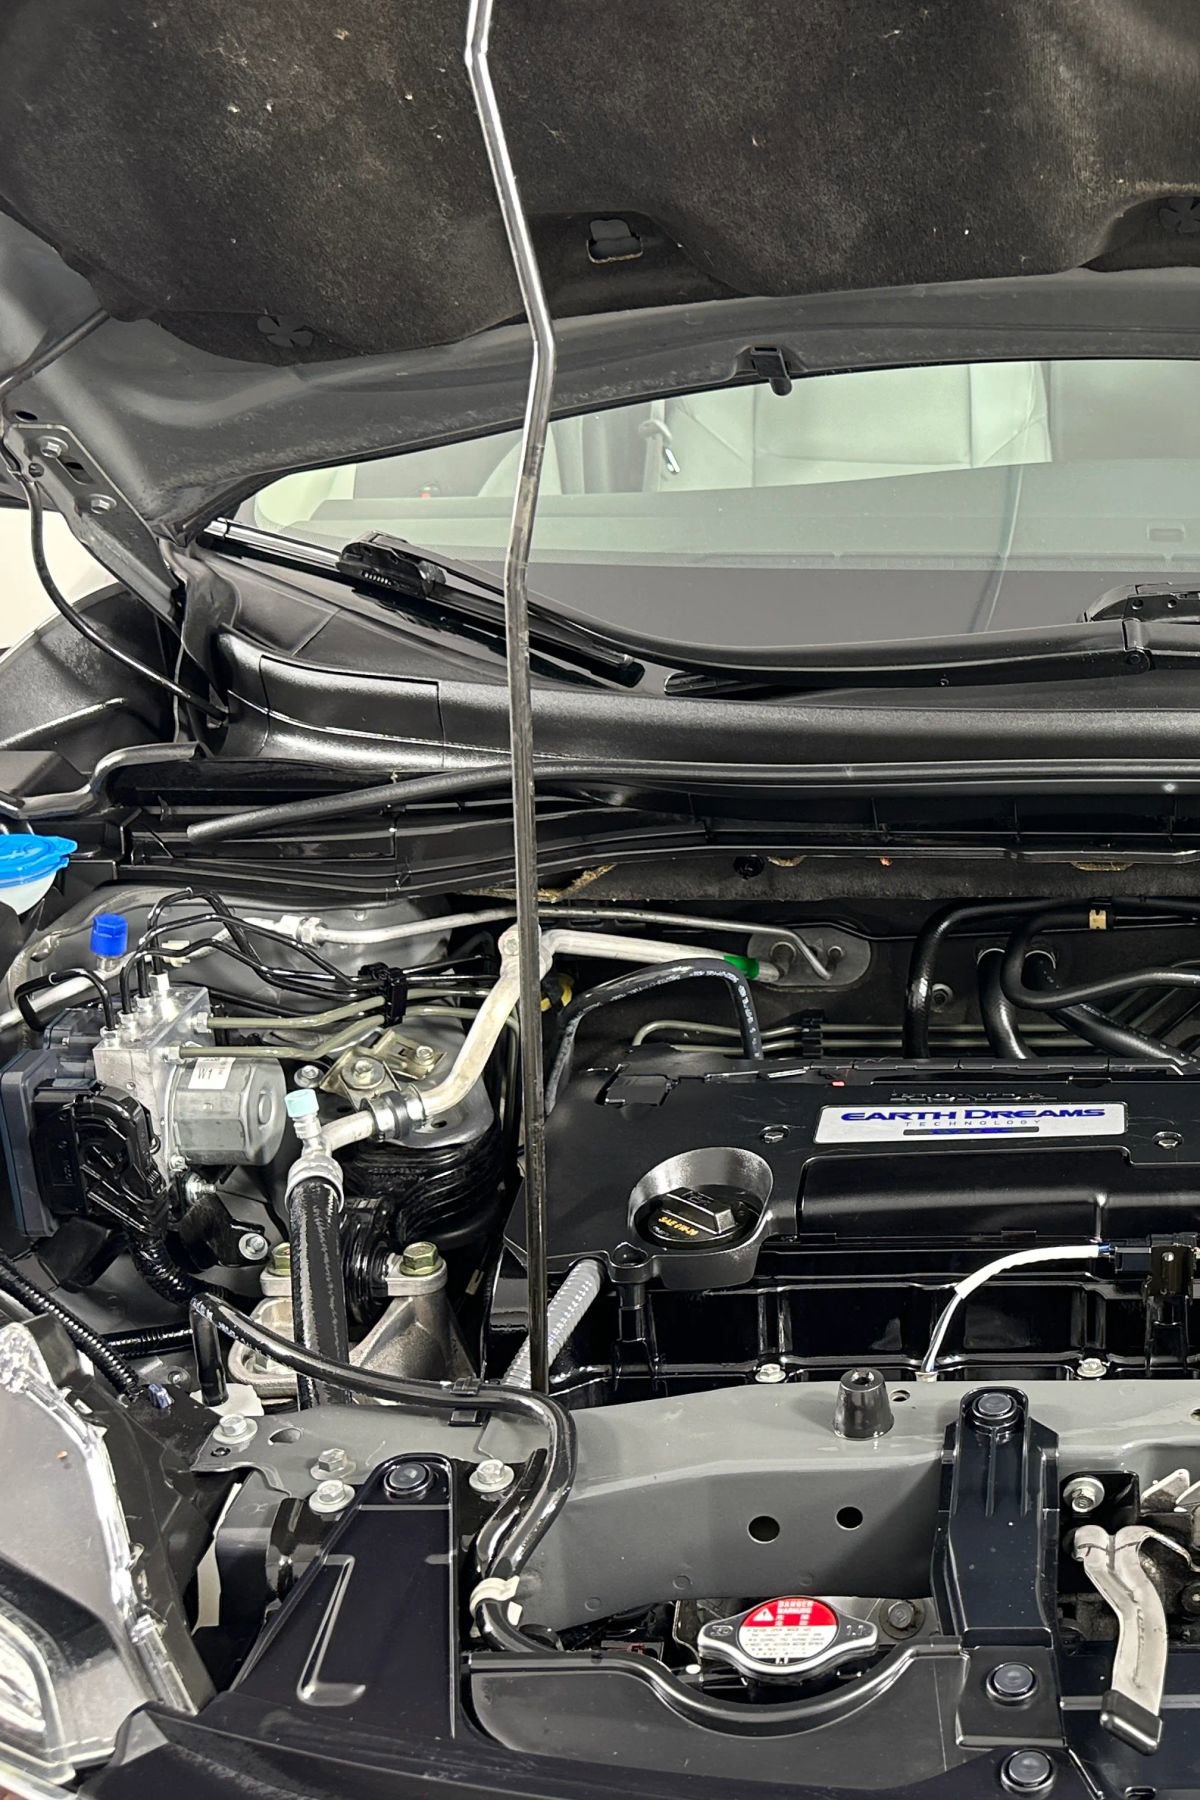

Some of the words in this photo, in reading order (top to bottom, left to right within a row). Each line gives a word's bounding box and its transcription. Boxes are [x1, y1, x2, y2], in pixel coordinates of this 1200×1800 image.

[840, 1111, 957, 1121] EARTH
[964, 1108, 1106, 1119] DREAMS
[904, 1119, 1041, 1127] TECHNOLOGY
